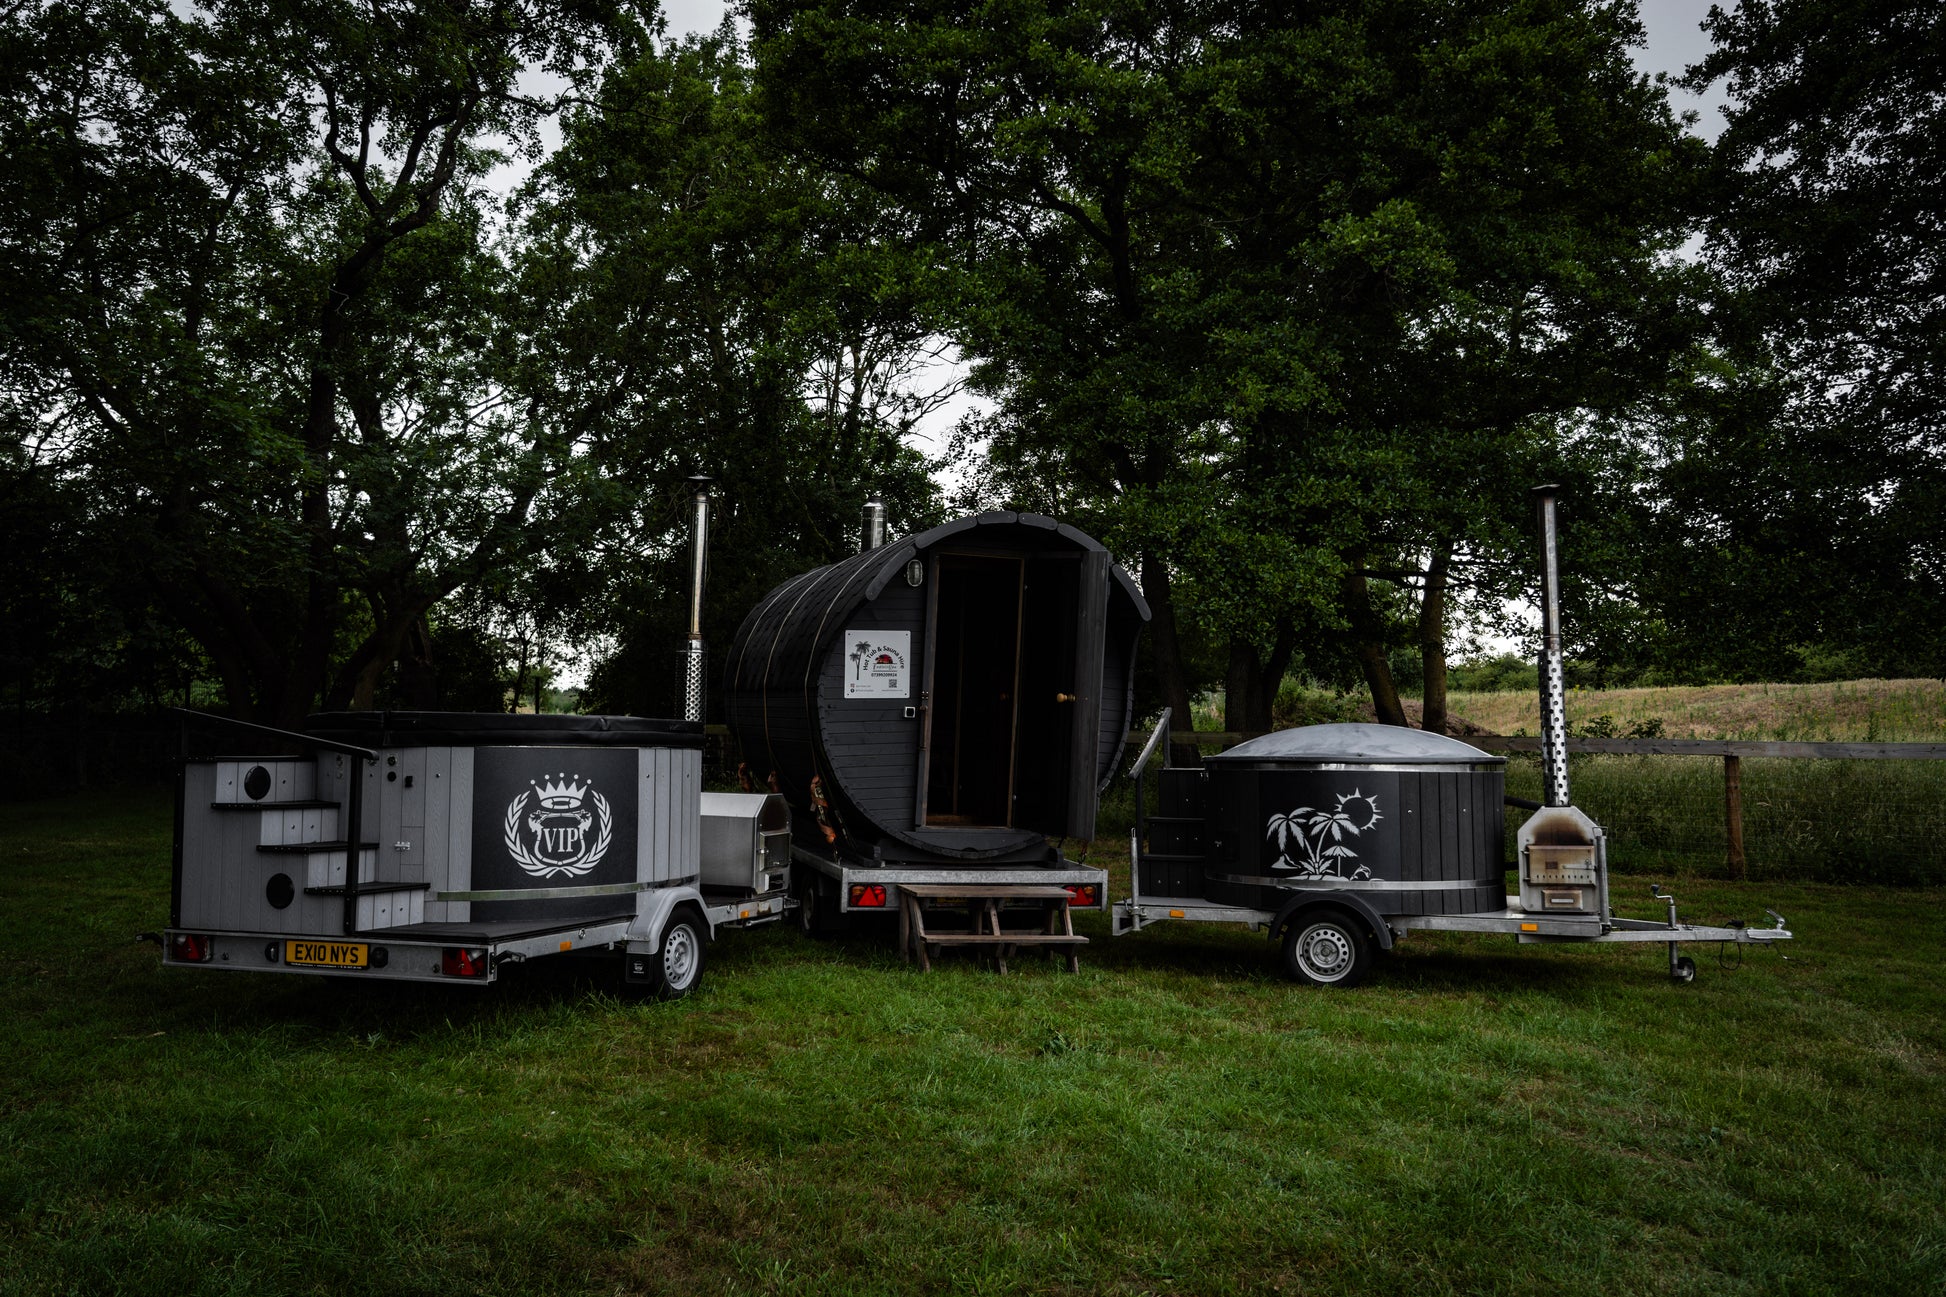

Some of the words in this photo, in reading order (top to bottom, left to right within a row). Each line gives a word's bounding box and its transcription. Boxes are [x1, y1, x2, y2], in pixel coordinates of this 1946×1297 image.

[866, 649, 877, 658] Tub
[882, 646, 899, 656] Sauna
[543, 827, 579, 853] VIP
[295, 943, 327, 962] EX10
[330, 945, 359, 963] NYS
